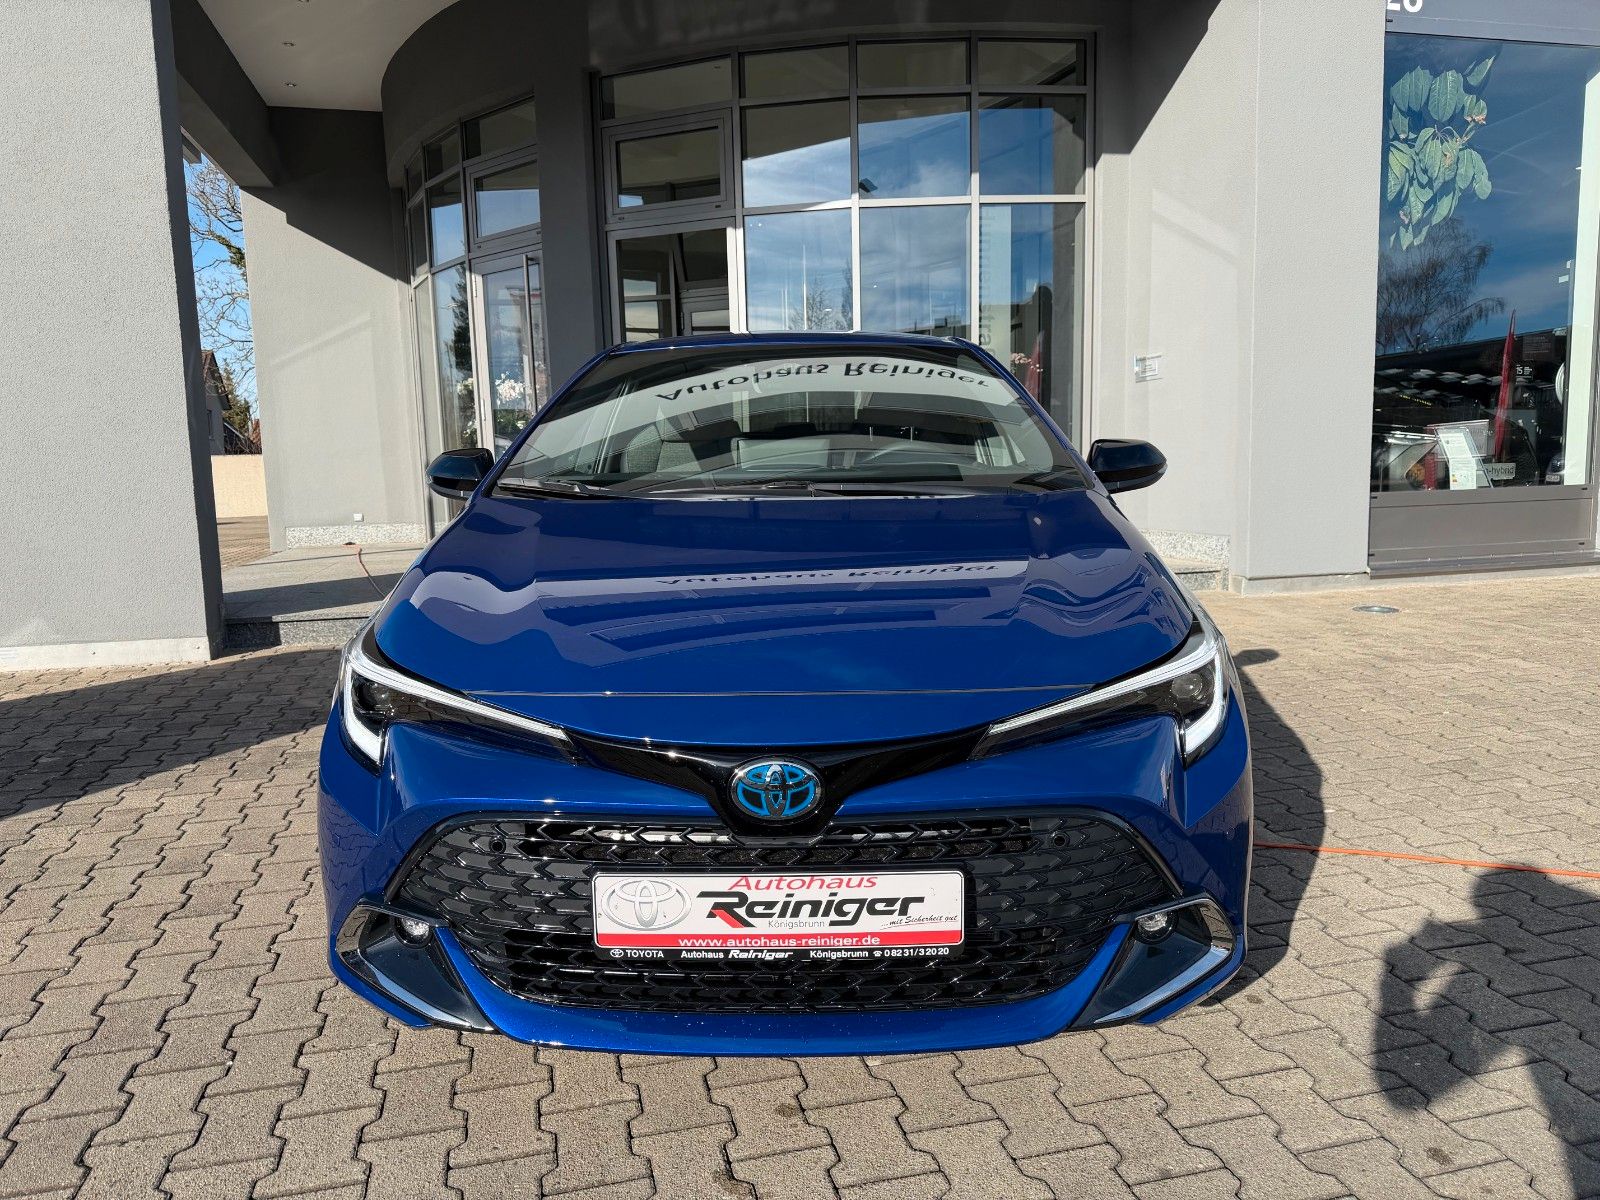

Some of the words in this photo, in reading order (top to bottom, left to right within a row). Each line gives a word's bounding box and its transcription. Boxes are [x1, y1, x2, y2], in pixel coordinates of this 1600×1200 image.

[727, 875, 878, 891] Autohaus
[697, 890, 926, 928] Reiniger
[768, 919, 826, 930] Königsbrunn
[905, 914, 944, 924] Sicherheit
[678, 935, 881, 948] www.autohaus-reiniger.de
[625, 949, 665, 958] TOYOTA
[680, 950, 725, 959] Autohaus
[728, 949, 794, 960] Reiniger
[810, 949, 869, 960] Königsbrunn
